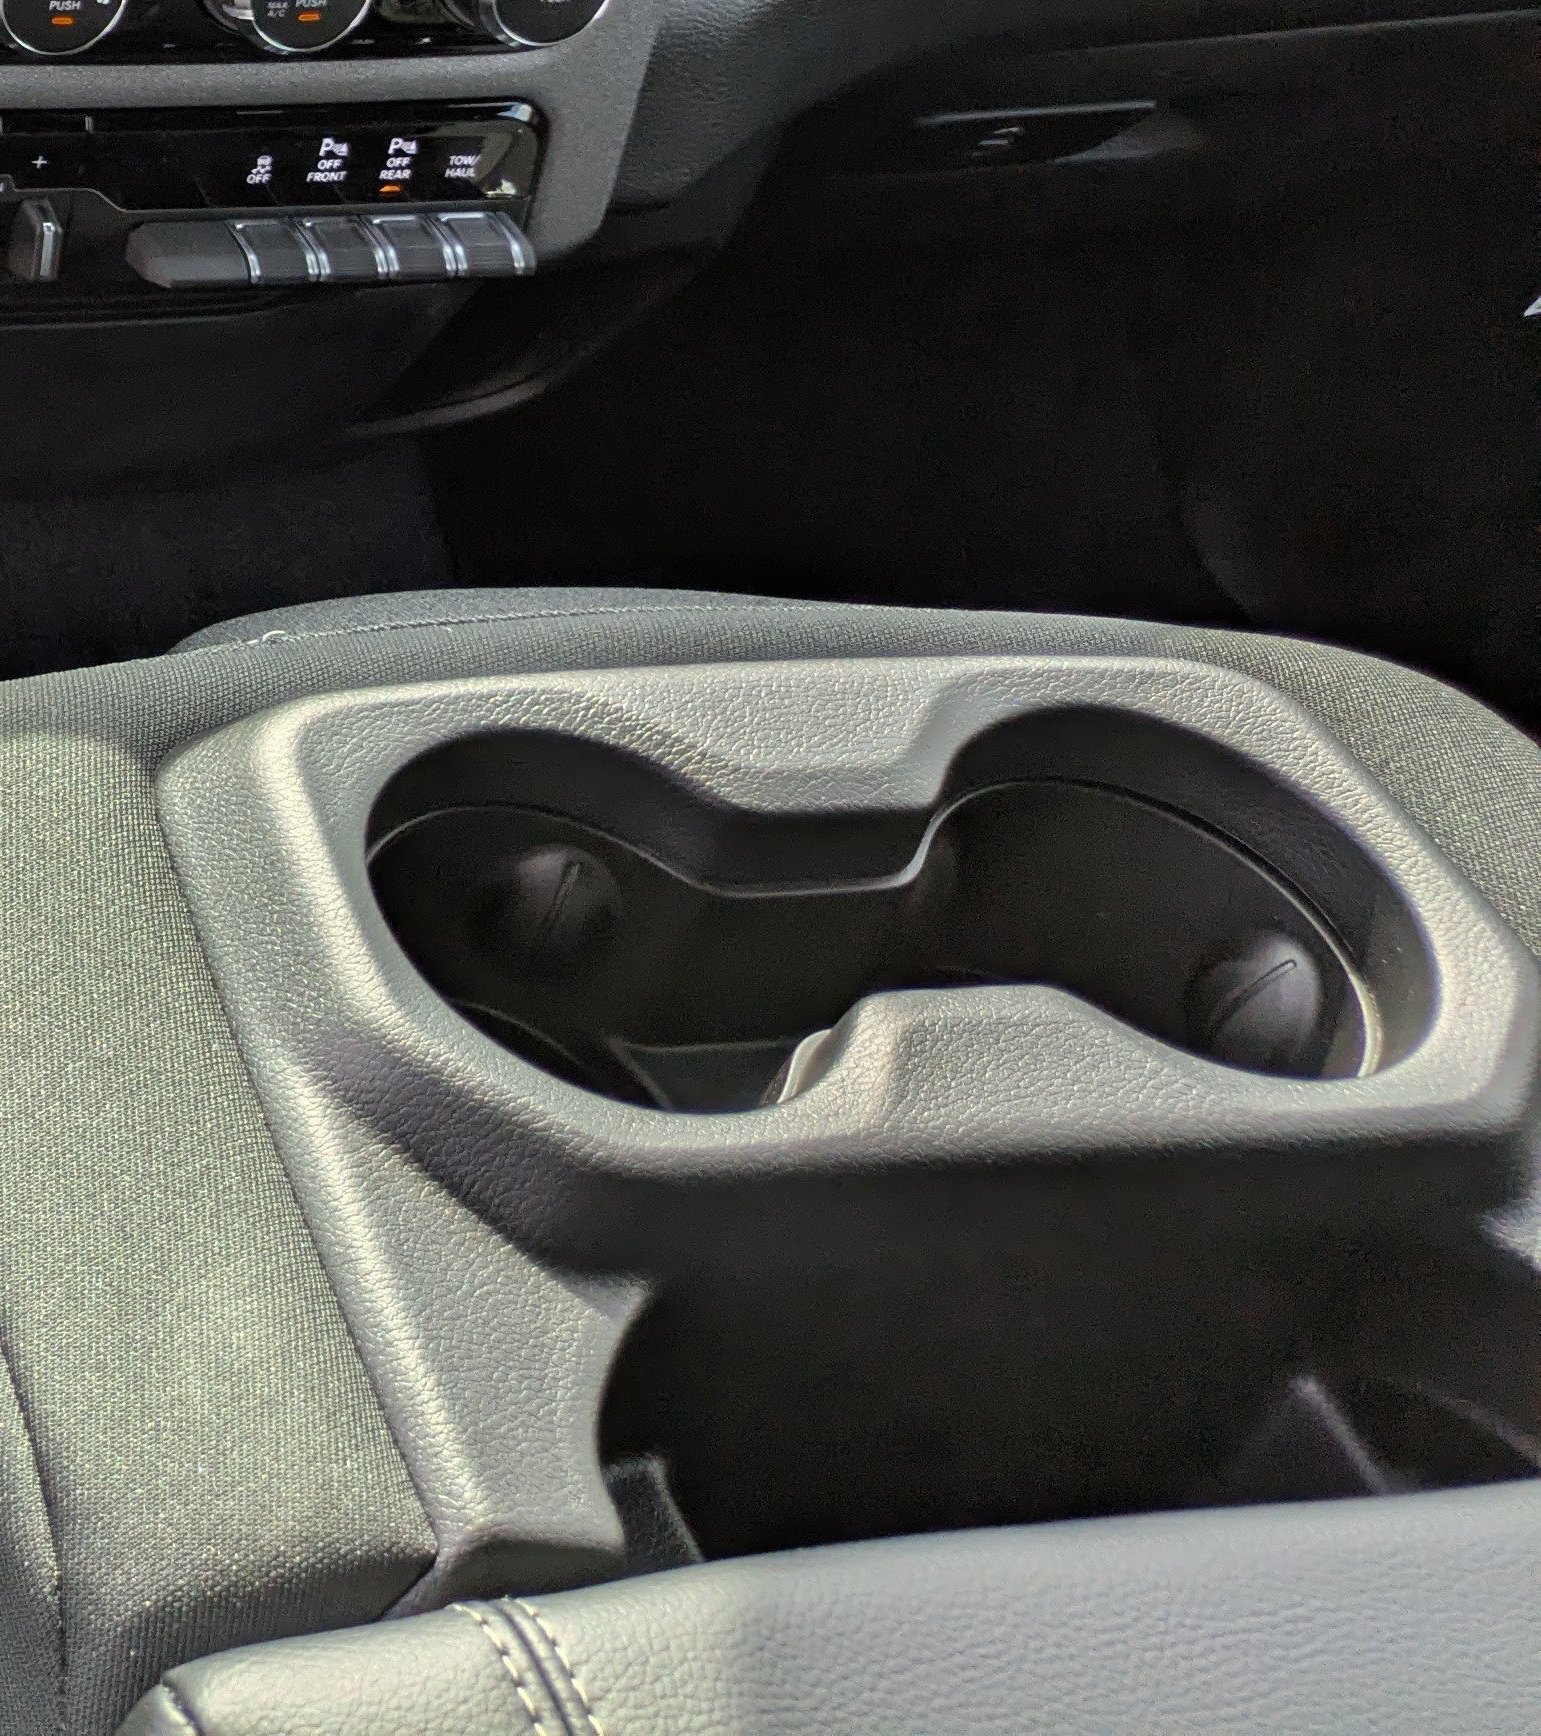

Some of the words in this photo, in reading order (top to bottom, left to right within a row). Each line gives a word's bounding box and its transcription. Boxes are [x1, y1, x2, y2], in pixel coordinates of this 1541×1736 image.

[49, 0, 81, 12] PUSH
[317, 159, 342, 170] OFF
[386, 157, 411, 168] OFF
[306, 170, 348, 183] FRONT
[379, 169, 411, 180] REAR
[445, 168, 476, 178] HAUL
[247, 174, 271, 185] OFF
